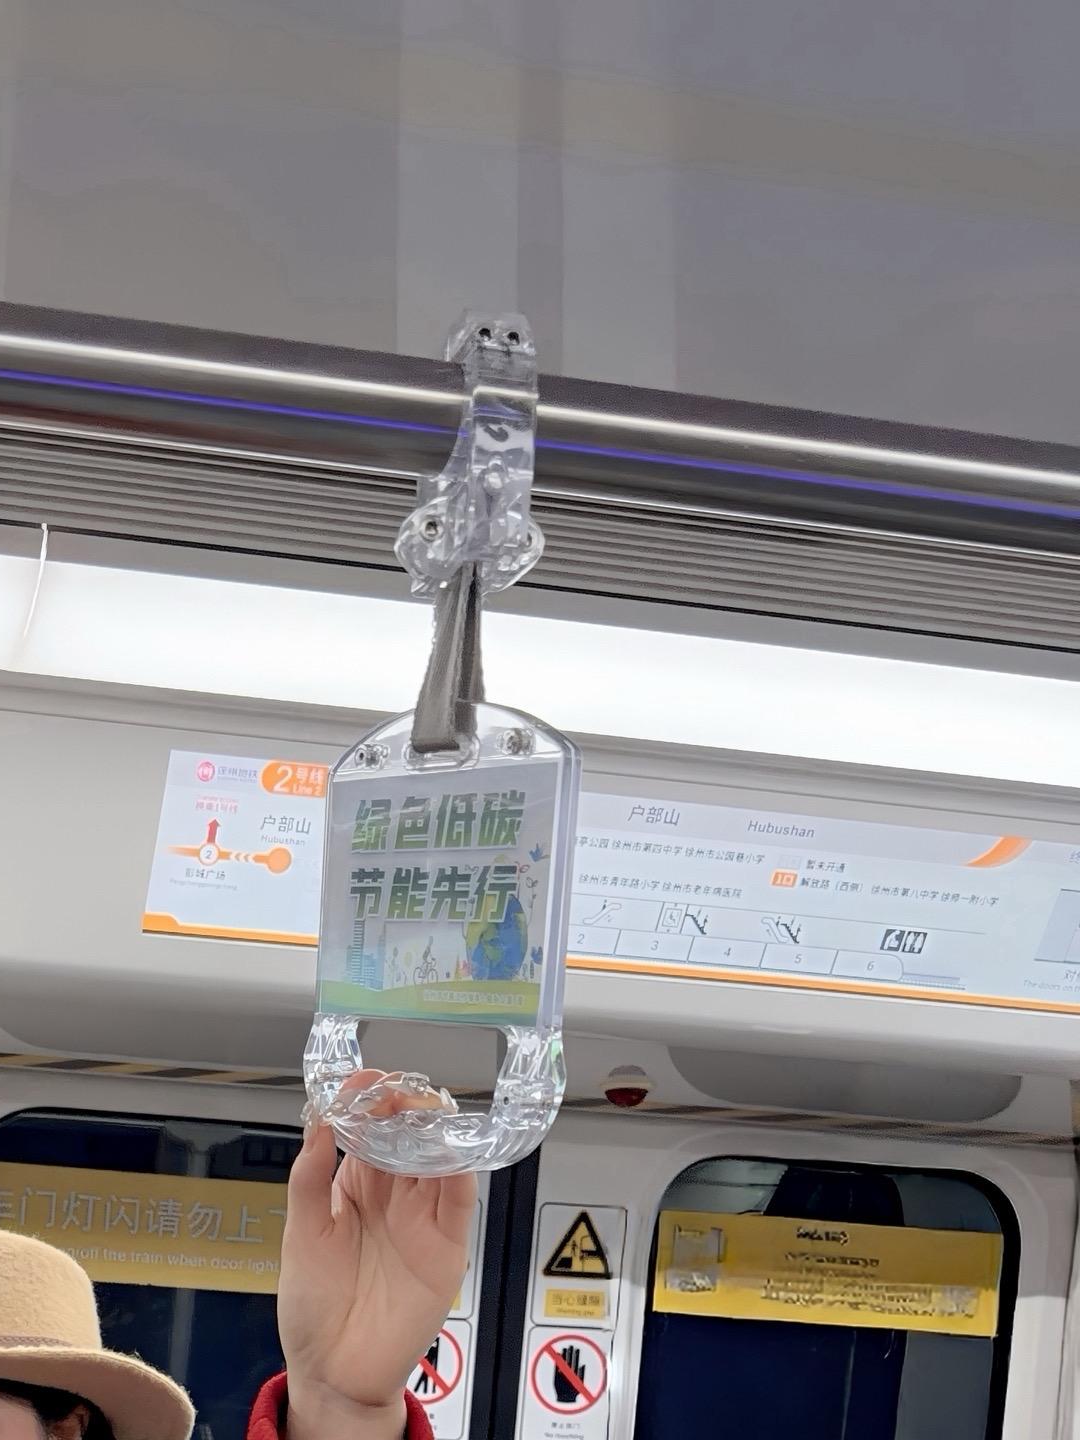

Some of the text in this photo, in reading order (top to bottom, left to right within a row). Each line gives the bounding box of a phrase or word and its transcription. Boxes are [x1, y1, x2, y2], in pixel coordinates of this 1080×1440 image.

[273, 765, 293, 793] 2
[260, 815, 312, 835] 户部山
[350, 790, 526, 852] 绿色低碳
[628, 804, 681, 827] 户部山
[748, 819, 815, 839] Hubushan
[261, 834, 306, 847] Hubushan
[350, 864, 519, 923] 节能先行
[577, 933, 585, 945] 2
[651, 940, 659, 951] 3
[723, 947, 732, 958] 4
[794, 953, 802, 964] 5
